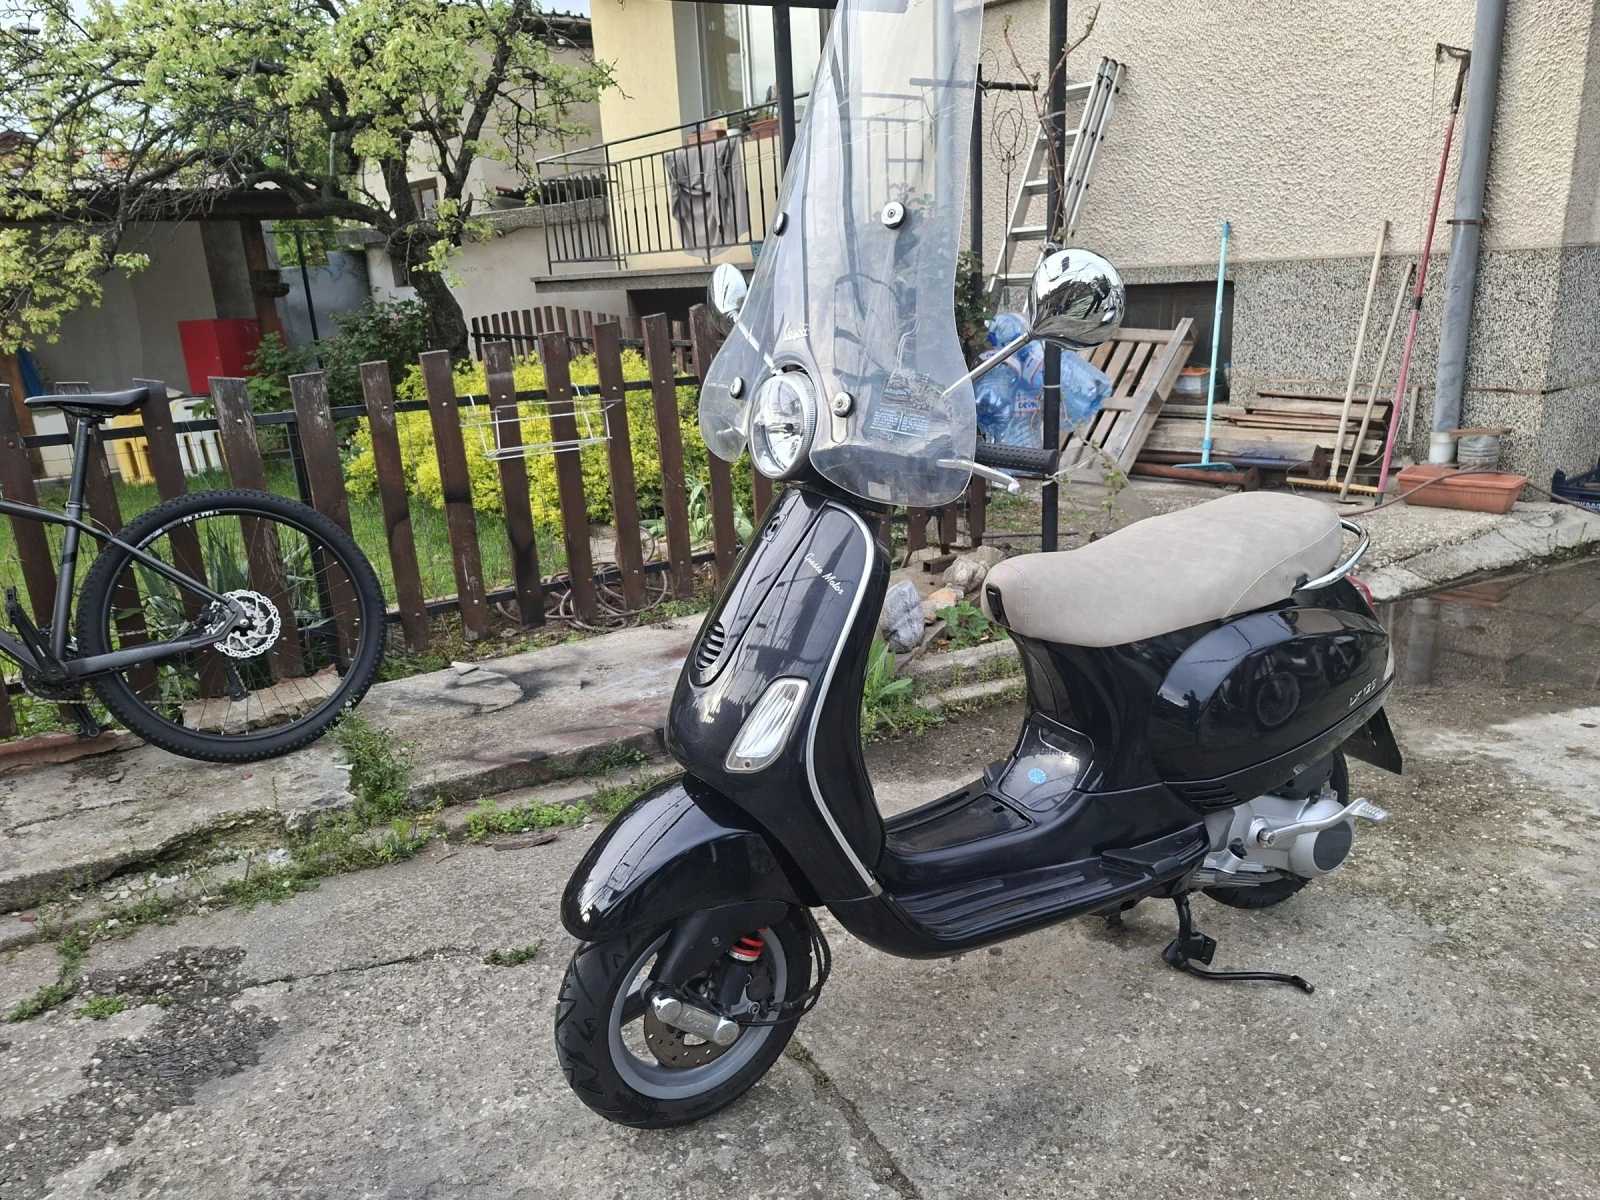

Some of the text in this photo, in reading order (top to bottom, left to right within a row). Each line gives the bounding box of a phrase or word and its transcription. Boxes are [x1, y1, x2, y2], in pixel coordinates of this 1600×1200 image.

[822, 572, 844, 595] Motor
[1348, 678, 1377, 708] LX 125
